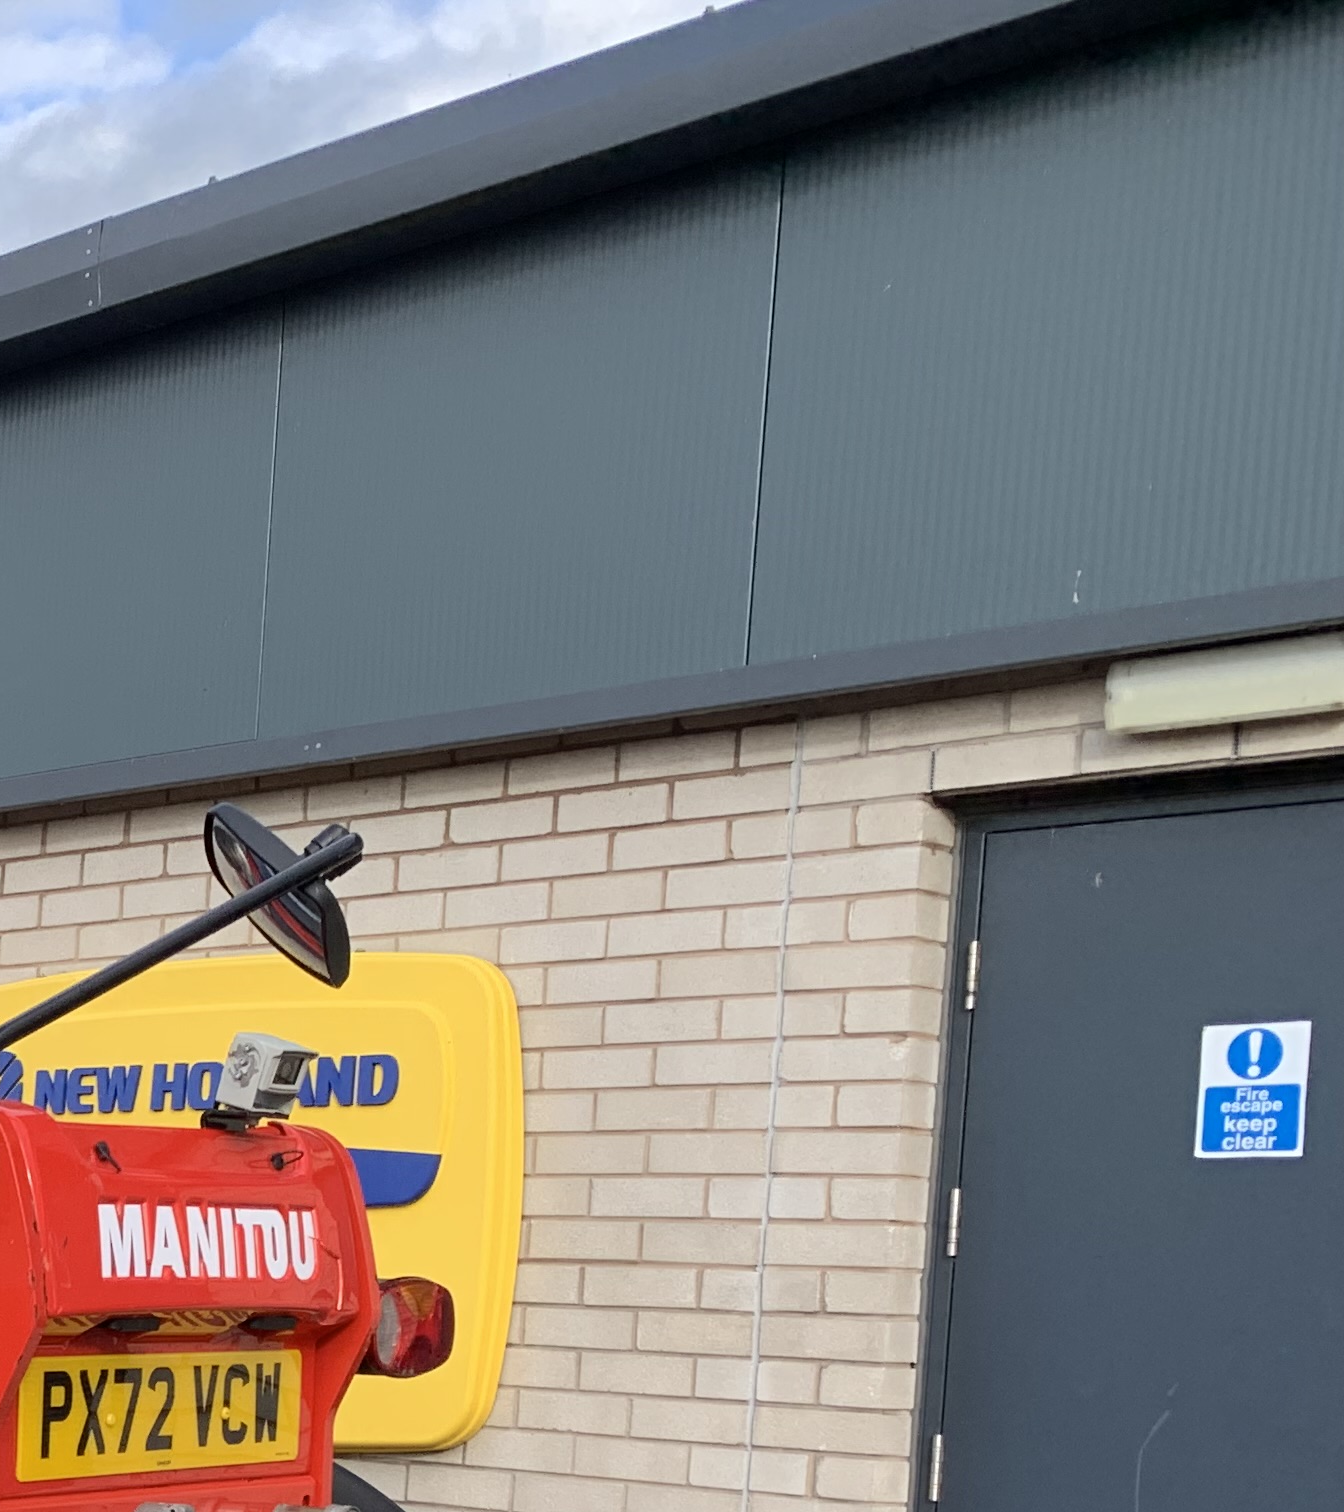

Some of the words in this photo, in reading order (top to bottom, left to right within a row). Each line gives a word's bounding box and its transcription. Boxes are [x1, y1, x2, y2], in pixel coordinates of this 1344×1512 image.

[34, 1065, 143, 1114] NEW
[151, 1055, 400, 1113] HOND
[1235, 1087, 1270, 1101] Fire
[1220, 1099, 1284, 1115] escape
[1223, 1115, 1278, 1136] keep
[1221, 1133, 1278, 1151] clear
[97, 1203, 316, 1281] MANITOU
[40, 1367, 176, 1459] PX72
[193, 1361, 282, 1447] VCW
